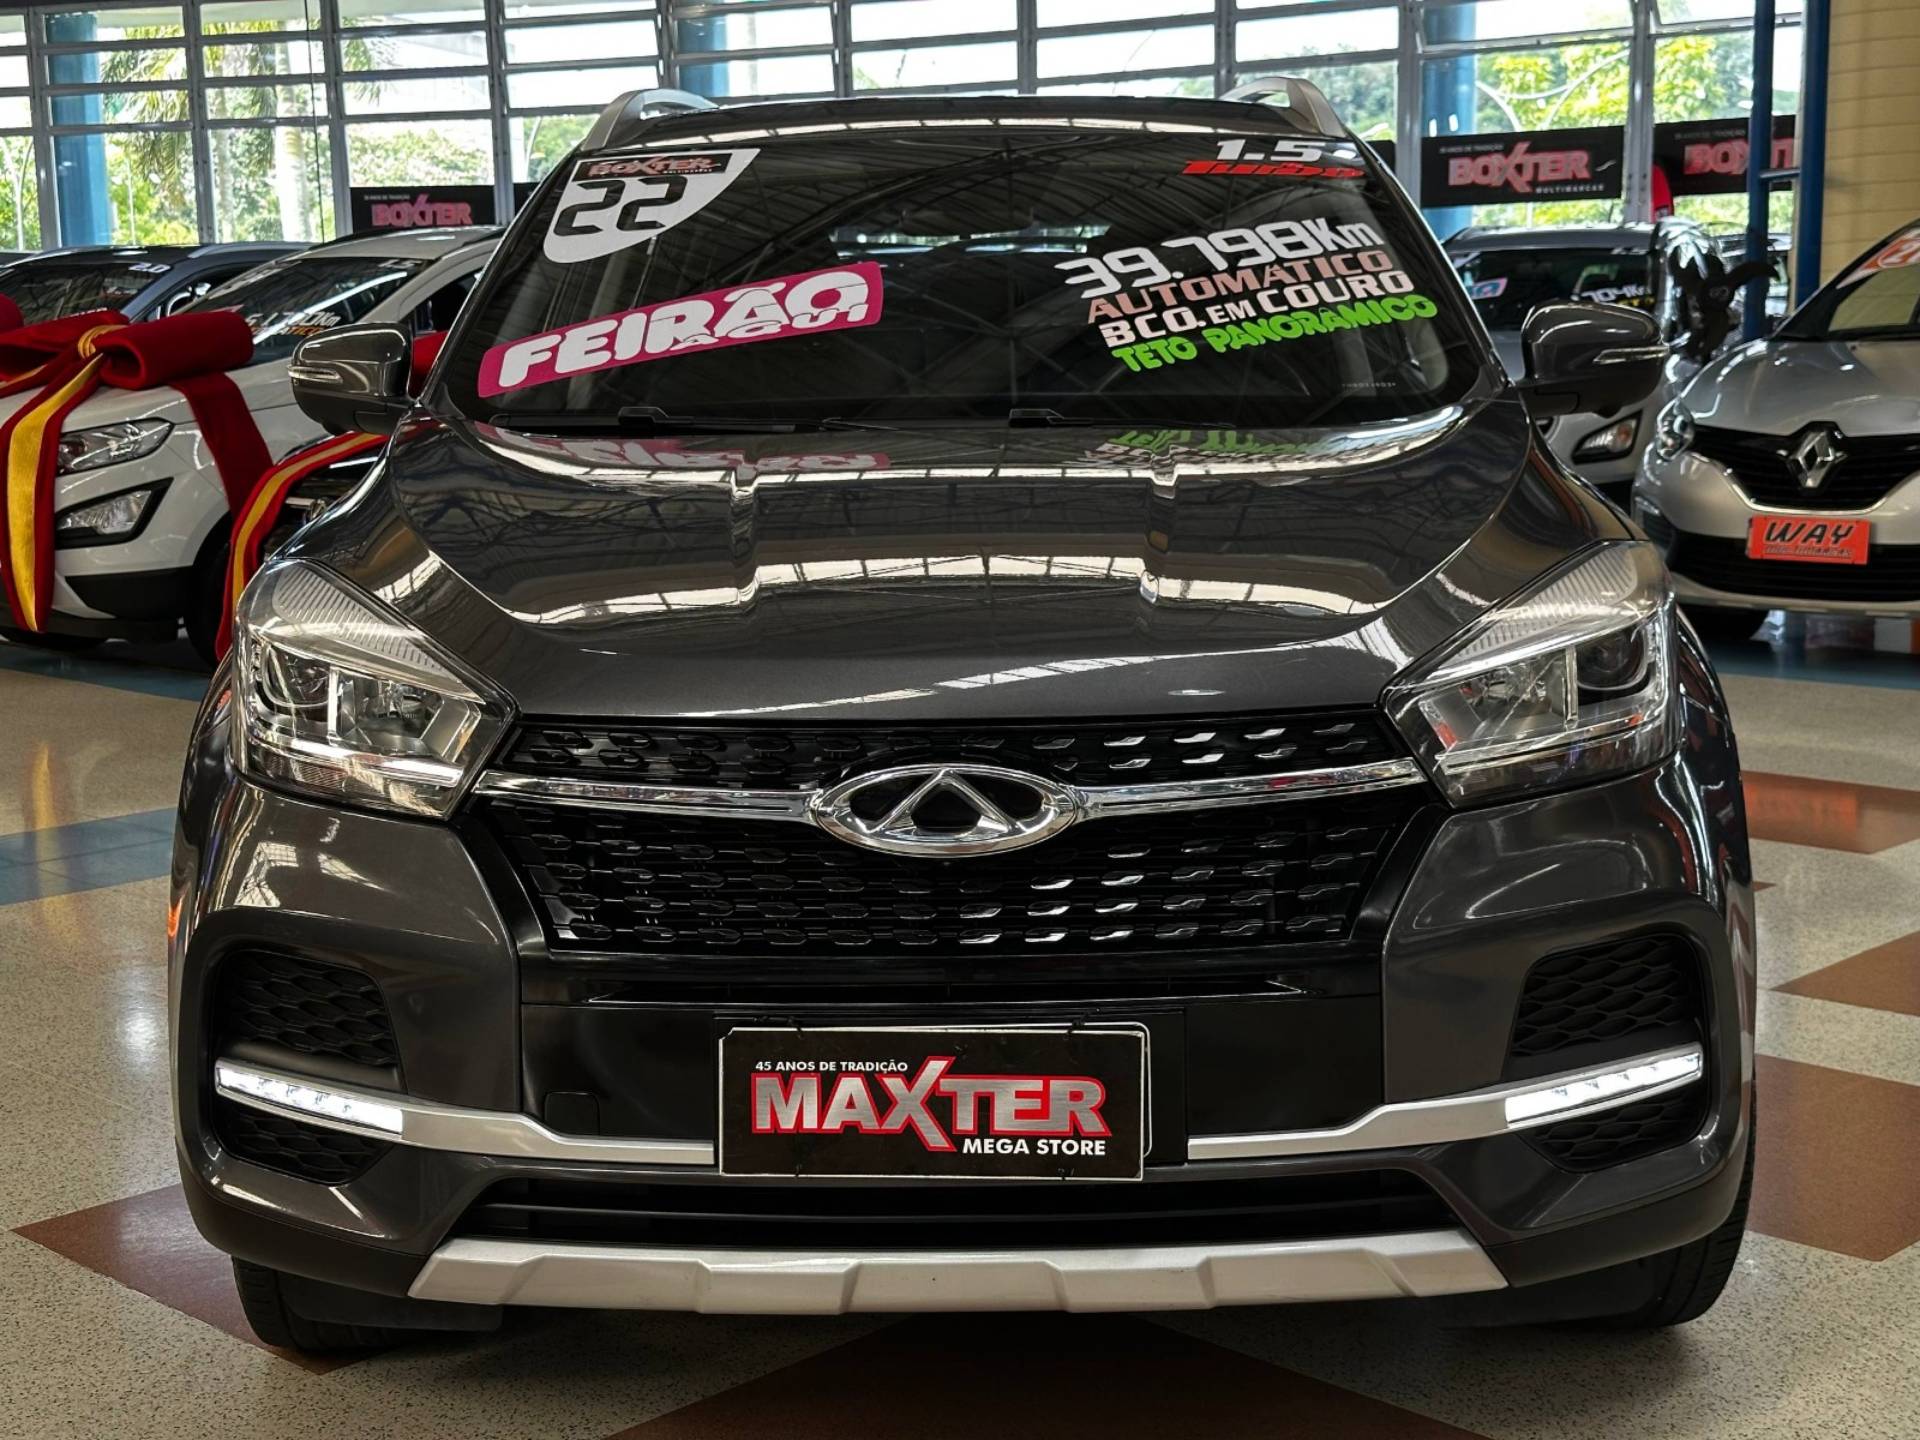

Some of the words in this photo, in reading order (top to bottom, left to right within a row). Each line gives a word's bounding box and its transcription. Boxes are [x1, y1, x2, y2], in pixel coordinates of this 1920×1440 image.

[588, 156, 721, 177] BOXTER
[1217, 139, 1326, 162] 1.5
[1447, 141, 1592, 193] BOXTER
[371, 194, 473, 227] BOXTER
[553, 175, 688, 236] 22
[1054, 217, 1385, 299] 39.798Km
[1088, 250, 1393, 324] AUTOMÁTICO
[1205, 299, 1257, 325] EM
[1256, 271, 1415, 314] COURO
[499, 272, 870, 388] FEIRÃO
[1111, 336, 1198, 372] TETO
[1201, 294, 1439, 353] PANORÂMICO
[1765, 522, 1853, 544] WAY
[755, 1061, 772, 1071] 45
[775, 1061, 816, 1071] ANOS
[819, 1061, 837, 1071] DE
[841, 1059, 908, 1074] TRADIÇÃO
[751, 1056, 1112, 1152] MAXTER
[962, 1138, 1030, 1155] MEGA
[1036, 1139, 1106, 1155] STORE
